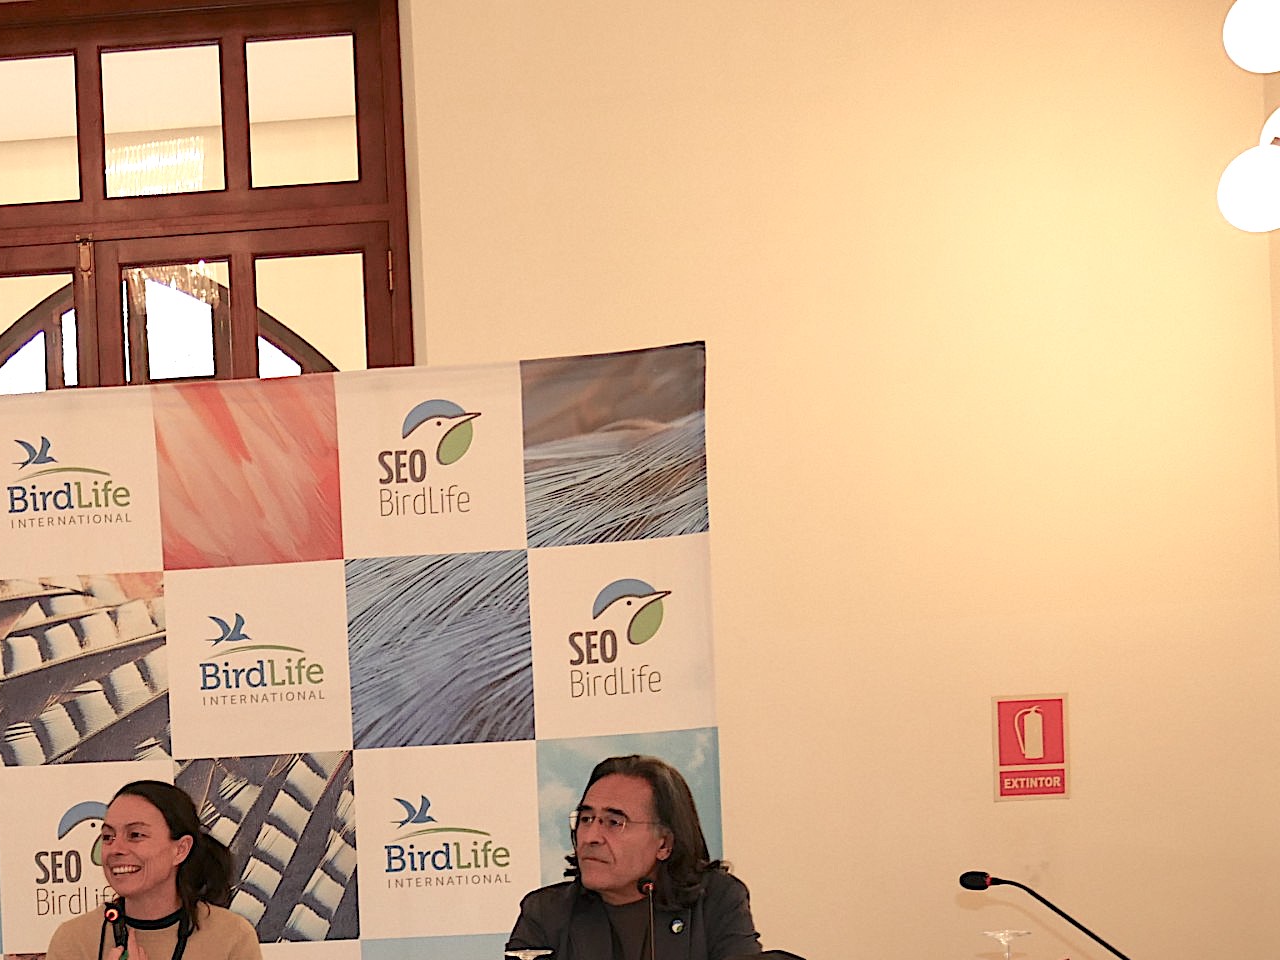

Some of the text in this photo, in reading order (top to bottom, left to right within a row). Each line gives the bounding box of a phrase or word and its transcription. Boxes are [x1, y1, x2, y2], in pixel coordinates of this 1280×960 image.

[378, 448, 426, 484] SEO
[7, 480, 130, 513] BirdLife
[379, 484, 470, 517] BirdLife
[11, 513, 132, 529] INTERNATIONAL
[569, 628, 617, 665] SEO
[199, 658, 325, 691] BirdLife
[570, 664, 662, 698] BirdLife
[202, 690, 326, 706] INTERNATIONAL
[1004, 776, 1061, 789] EXTINTOR
[35, 850, 82, 884] SEO
[384, 841, 510, 874] BirdLife
[387, 873, 511, 889] INTERNATIONAL
